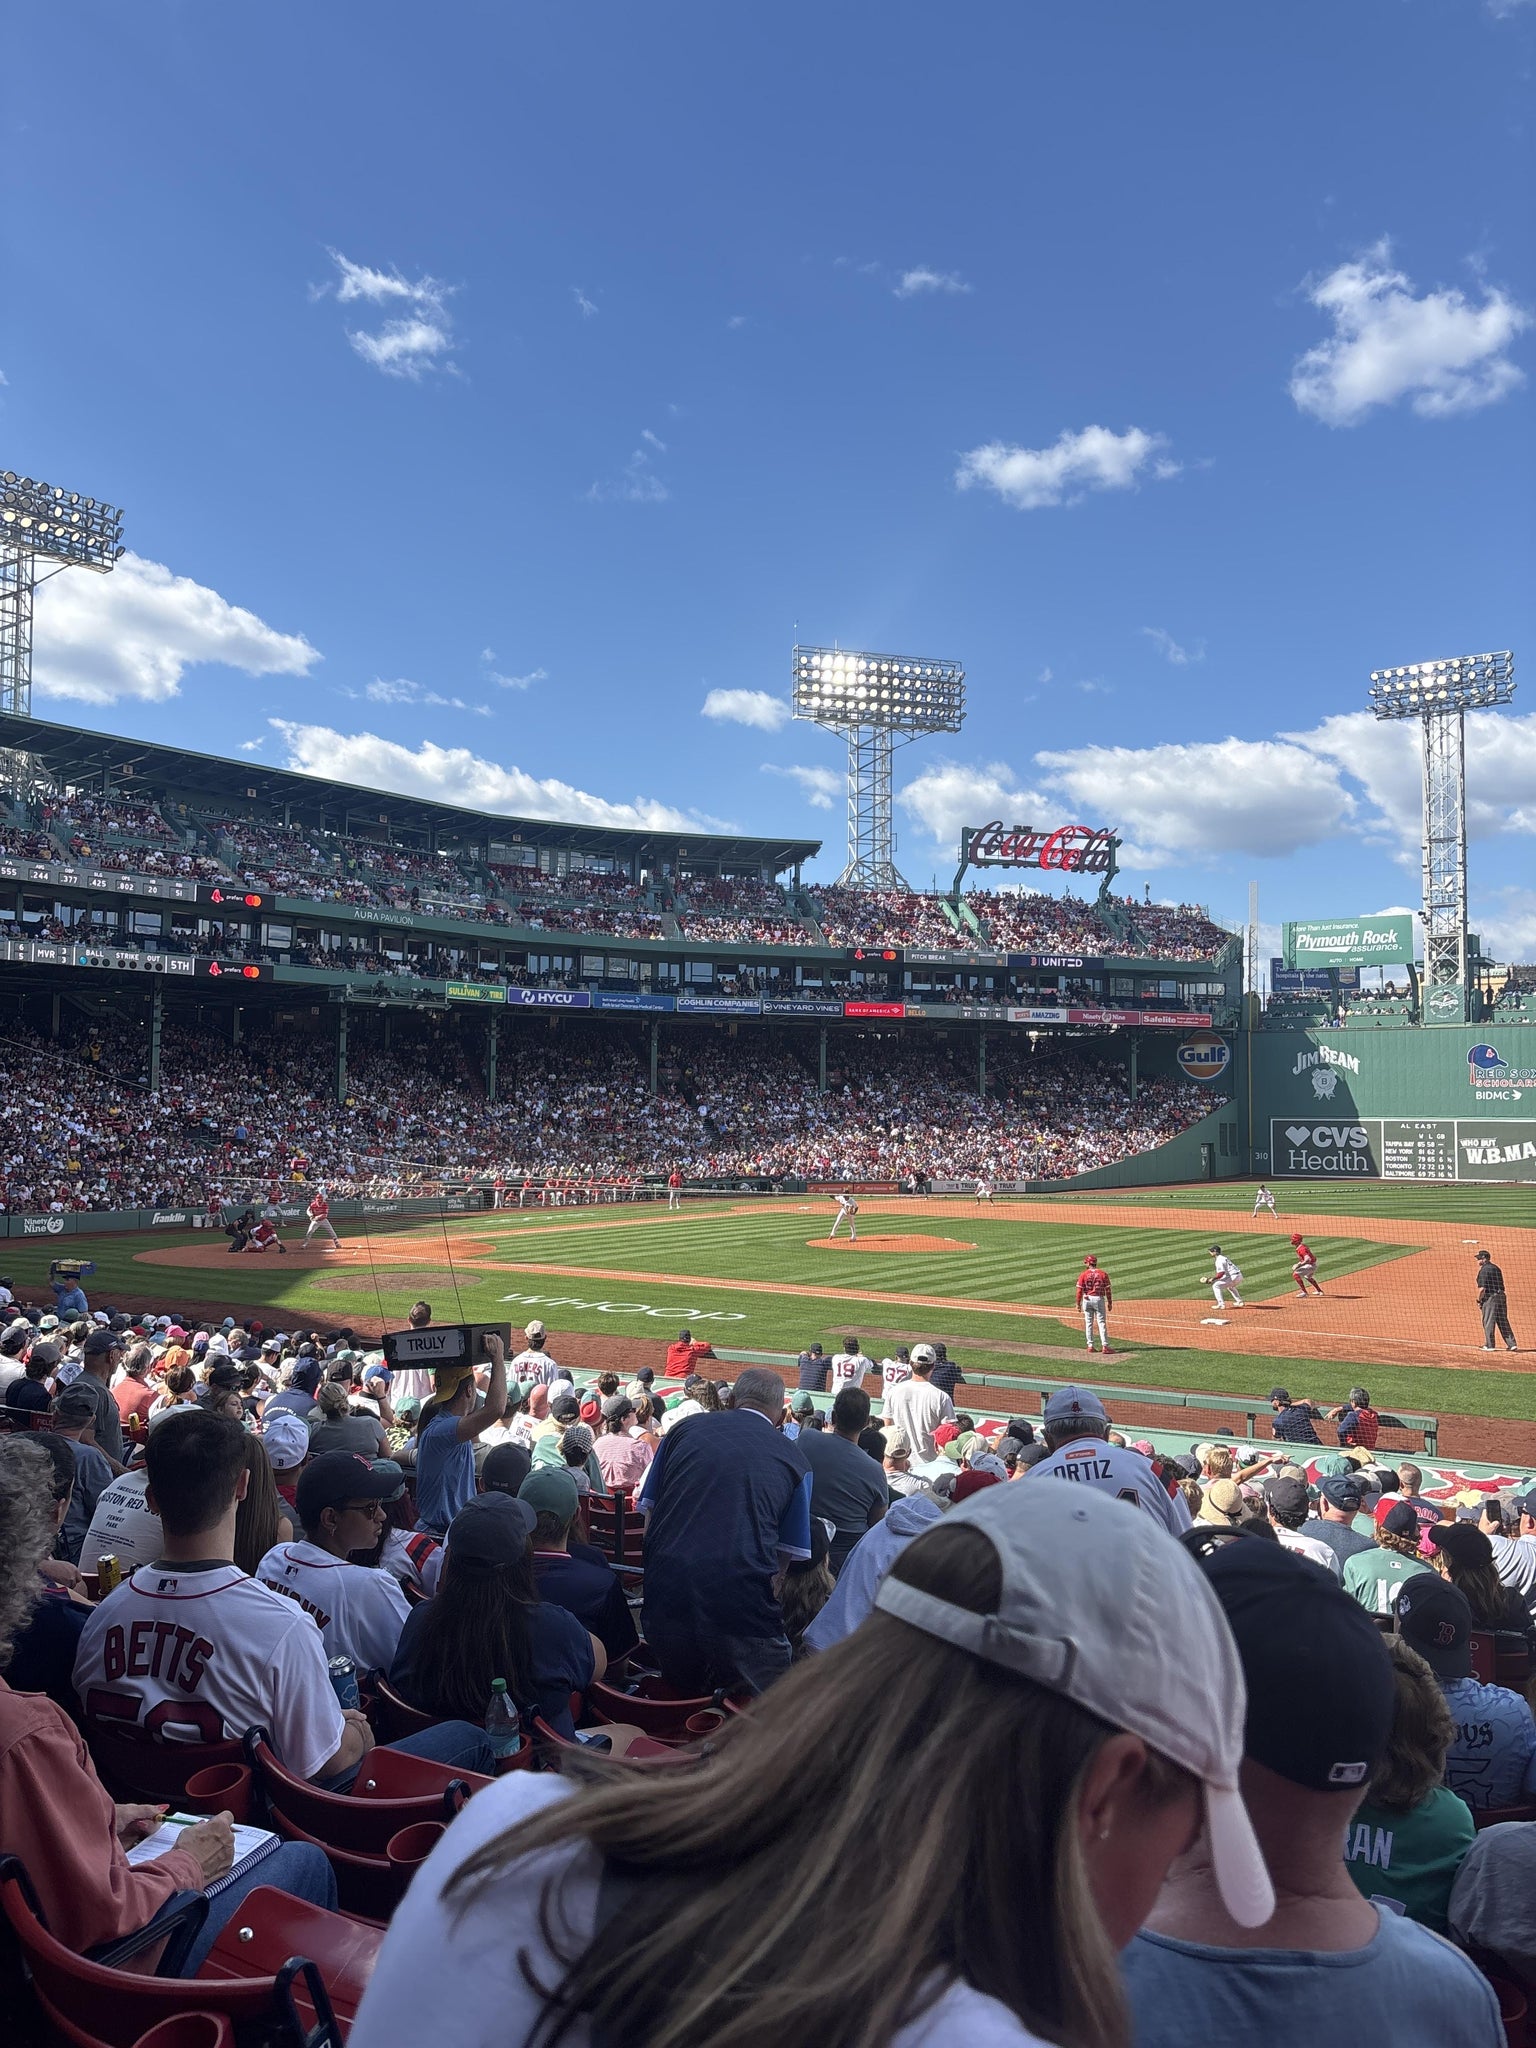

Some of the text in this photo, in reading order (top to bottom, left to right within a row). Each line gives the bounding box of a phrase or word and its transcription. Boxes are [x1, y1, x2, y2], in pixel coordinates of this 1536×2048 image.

[1, 867, 17, 876] 555
[30, 871, 48, 880] .244
[60, 876, 78, 884] .377
[89, 879, 107, 888] .425
[148, 886, 158, 894] 20
[380, 913, 414, 925] PAVILION
[1296, 929, 1398, 949] Plymouth Rock
[19, 943, 24, 951] 6
[37, 949, 55, 959] MVR
[85, 949, 104, 958] BALL
[115, 952, 139, 960] STRIKE
[170, 960, 189, 971] 5TH
[1042, 957, 1083, 967] UNITED
[448, 987, 503, 999] SULLIVAN TIRE
[538, 993, 572, 1003] HYCU
[679, 998, 713, 1006] COGHLIN
[773, 1003, 840, 1012] VINEYARD VINES
[1082, 1013, 1101, 1021] Ninety
[1143, 1015, 1177, 1024] Safelite
[1178, 1046, 1226, 1063] Gulf
[1292, 1045, 1360, 1075] JIM BEAM
[1476, 1068, 1505, 1078] RED
[1475, 1091, 1510, 1100] BIDMC
[1312, 1126, 1368, 1148] CVS
[1460, 1139, 1497, 1147] WHO BUT
[1255, 1152, 1268, 1160] 310
[1288, 1150, 1369, 1171] Health
[376, 1205, 397, 1213] TICKET
[24, 1224, 47, 1233] Nine
[496, 1293, 747, 1320] WHOOP
[406, 1335, 447, 1351] TRULY
[885, 1367, 908, 1384] 37
[1053, 1459, 1114, 1481] ORTIZ
[125, 1497, 144, 1510] RED
[106, 1514, 126, 1523] FENWAY
[103, 1620, 215, 1694] BETTS
